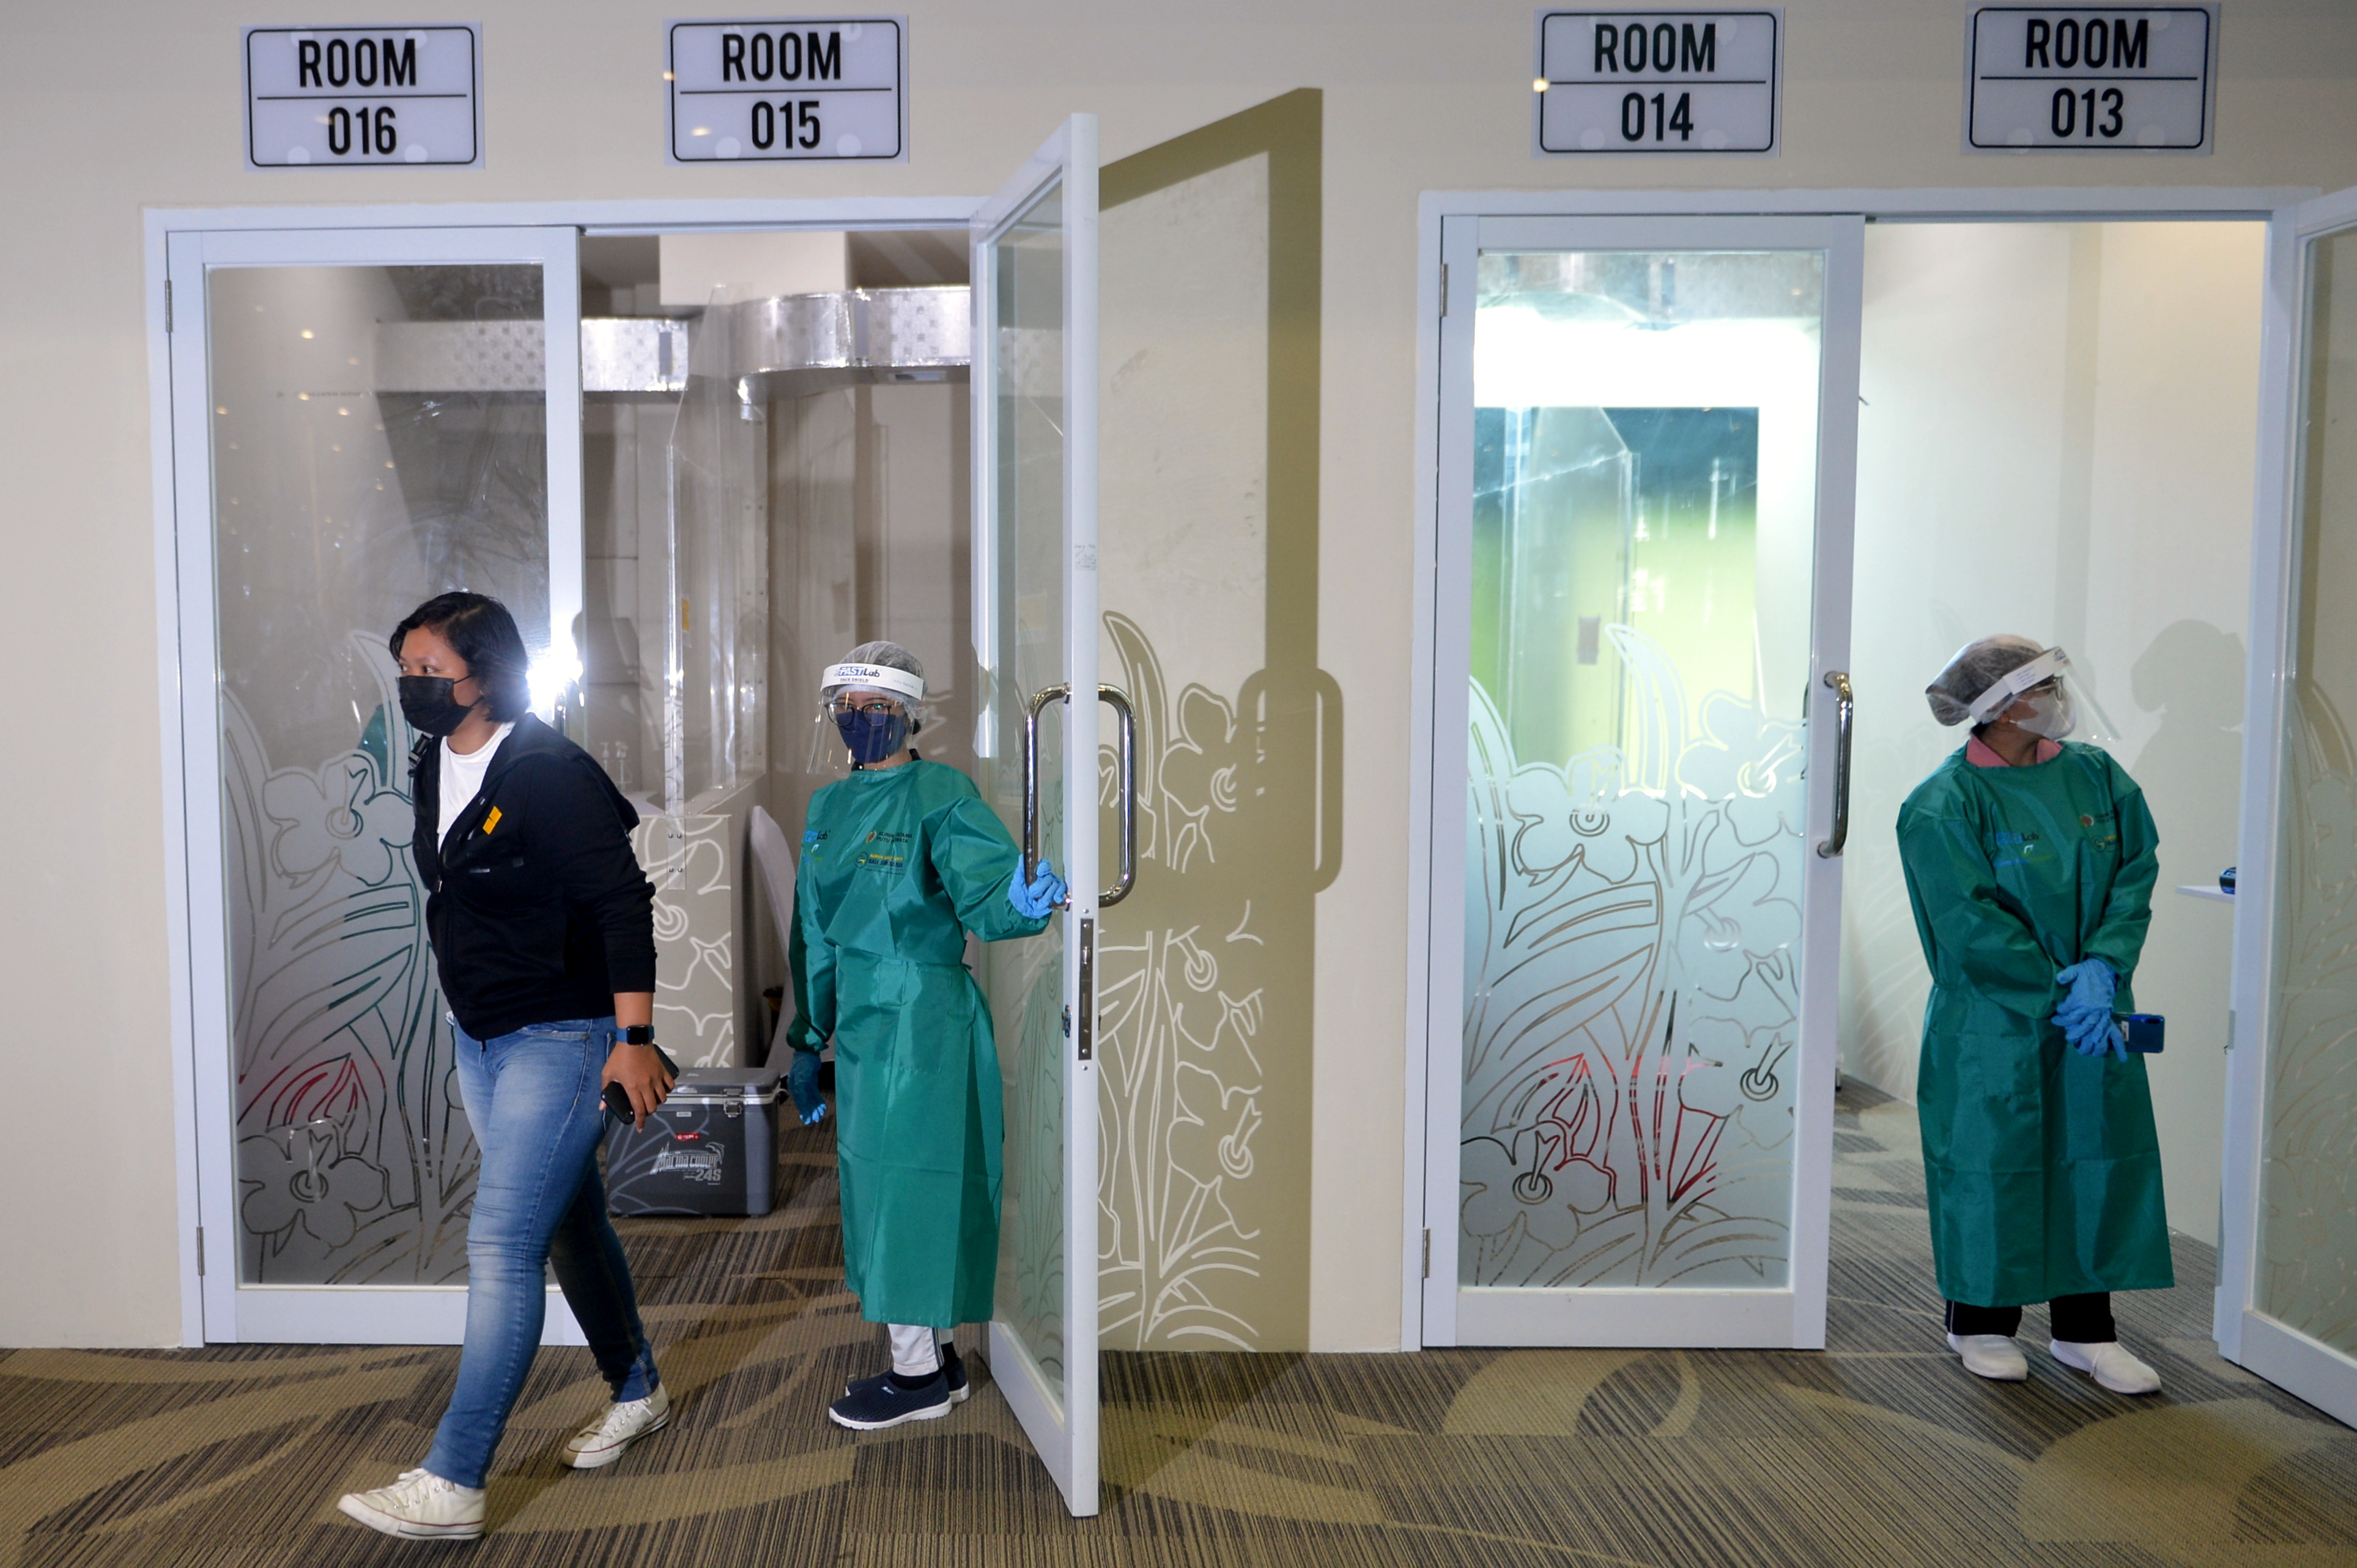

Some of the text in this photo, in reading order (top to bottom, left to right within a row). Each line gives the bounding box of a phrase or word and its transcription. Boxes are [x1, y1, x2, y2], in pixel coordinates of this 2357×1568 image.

[298, 38, 416, 87] ROOM
[722, 31, 842, 82] ROOM
[1594, 22, 1716, 73] ROOM
[2025, 17, 2150, 70] ROOM
[327, 106, 397, 155] 016
[751, 100, 821, 150] 015
[1621, 92, 1694, 142] 014
[2051, 87, 2124, 139] 013
[695, 1169, 722, 1182] 24S
